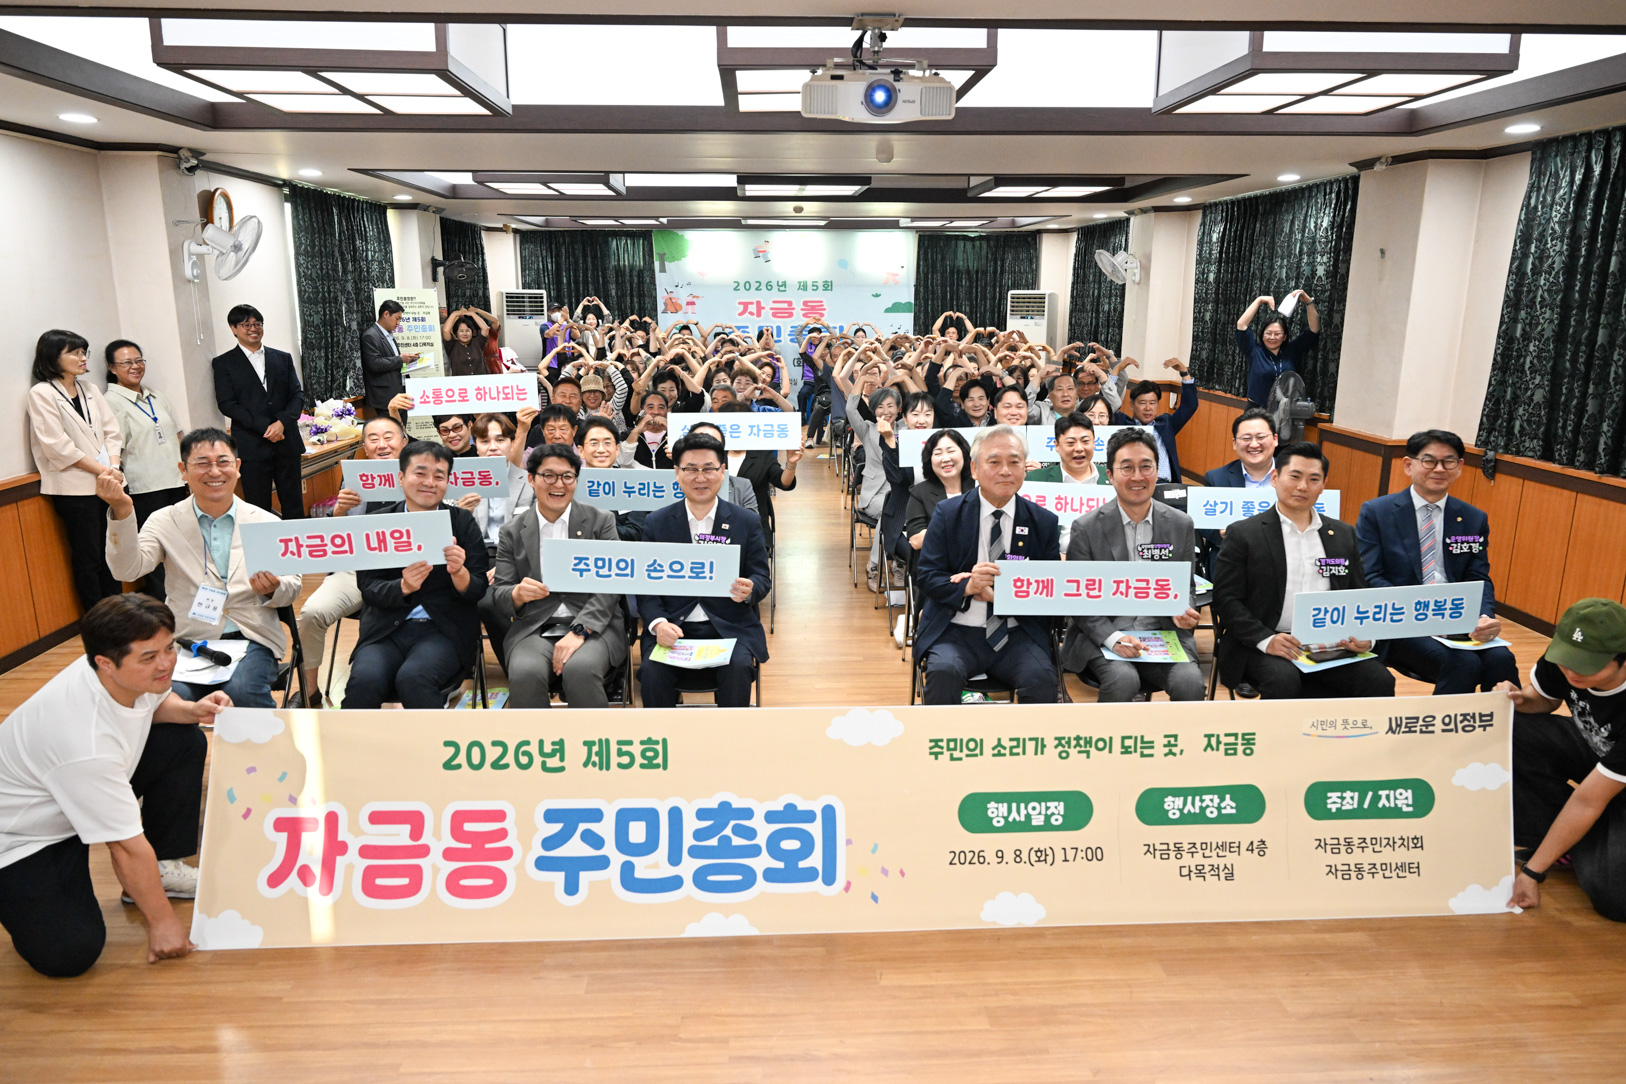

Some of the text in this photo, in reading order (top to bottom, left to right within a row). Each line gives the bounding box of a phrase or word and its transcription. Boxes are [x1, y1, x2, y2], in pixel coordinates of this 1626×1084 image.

[732, 280, 833, 292] 2026년 제5회
[737, 300, 827, 319] 자금동
[419, 385, 527, 406] 소통으로 하나되는
[748, 424, 789, 439] 자금동
[358, 472, 395, 489] 함께
[587, 480, 615, 498] 같이
[623, 481, 665, 498] 누리는
[1055, 495, 1107, 514] 하나되
[1203, 500, 1233, 516] 살기
[279, 529, 422, 558] 자금의 내일,
[1143, 549, 1169, 560] 최병선
[572, 556, 714, 580] 주민의 손으로!
[1321, 566, 1346, 577] 김지호
[1012, 577, 1178, 600] 함께 그린 자금동,
[1312, 598, 1465, 628] 같이 누리는 행복동
[1572, 628, 1584, 642] LA
[1310, 718, 1373, 731] 시민의 뜻으로,
[1385, 712, 1494, 735] 새로운 의정부
[442, 737, 668, 773] 2026년 제5회
[928, 732, 1256, 762] 주민의 소리가 정책이 되는 곳, 자금동
[1163, 794, 1237, 819] 행사장소
[1326, 791, 1358, 812] 주최
[1378, 789, 1414, 812] 지원
[986, 801, 1064, 827] 행사일정
[266, 800, 837, 900] 자금동 주민총회
[1143, 839, 1268, 861] 자금동주민센터 4층
[1314, 835, 1424, 855] 자금동주민자치회
[948, 846, 1104, 867] 2026. 9. 8.(화) 17:00
[1179, 863, 1235, 882] 다목적실
[1326, 862, 1421, 881] 자금동주민센터
